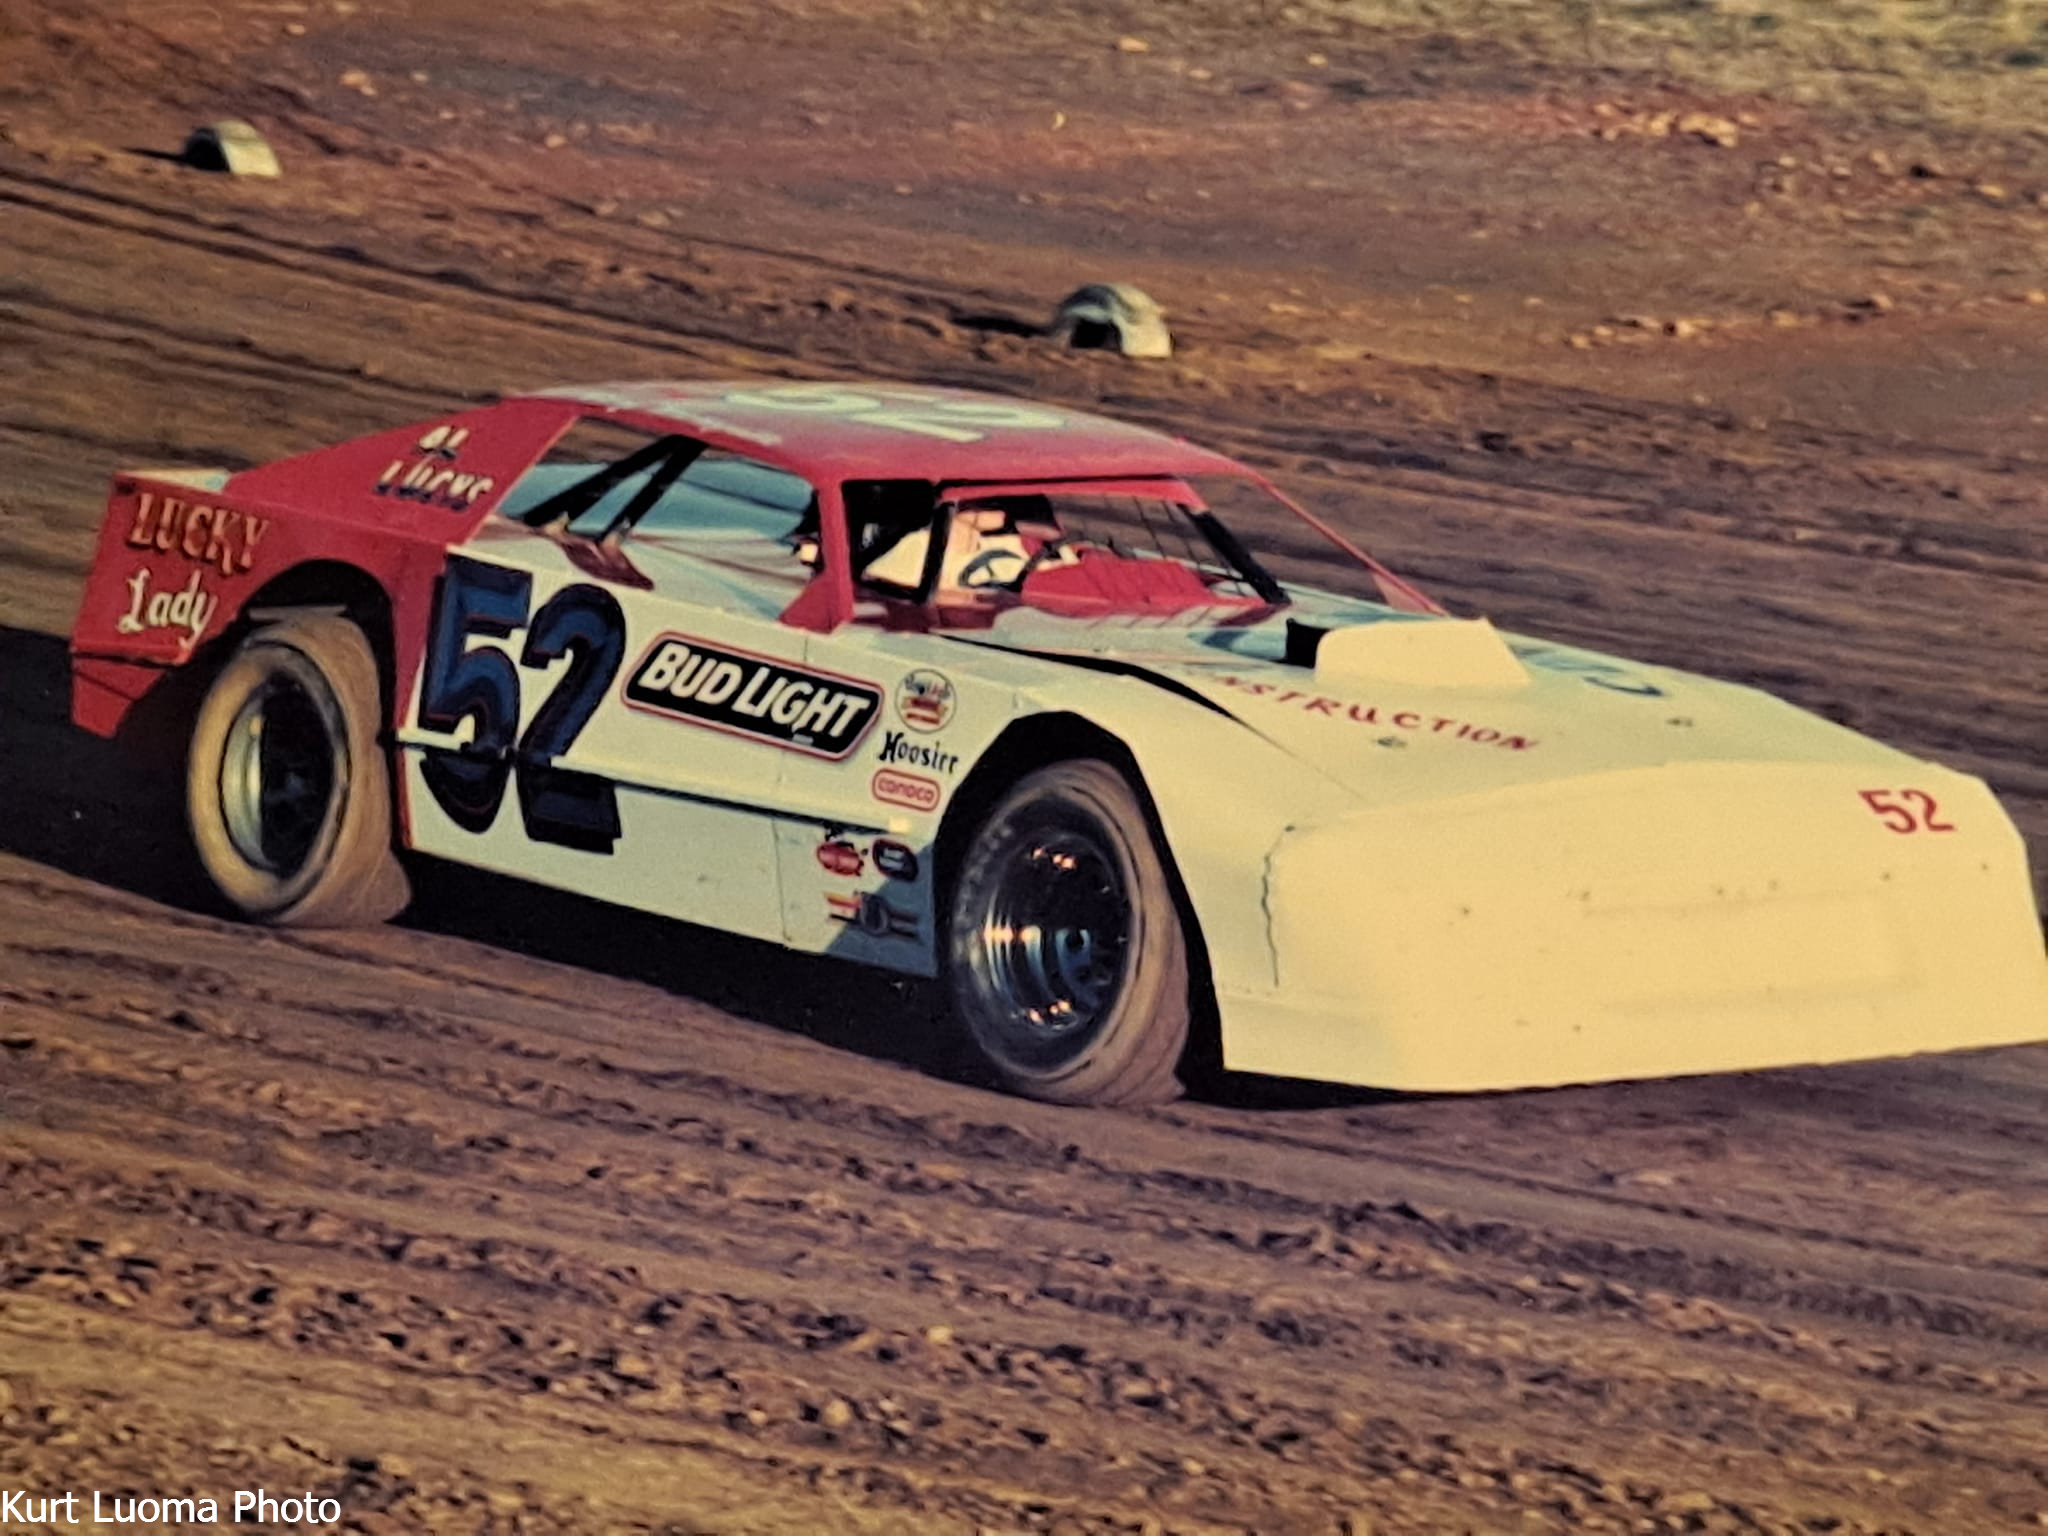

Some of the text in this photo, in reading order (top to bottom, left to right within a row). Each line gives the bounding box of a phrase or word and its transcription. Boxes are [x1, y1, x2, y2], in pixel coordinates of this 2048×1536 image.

[126, 492, 270, 577] LUCKY
[115, 567, 219, 650] Lady
[417, 553, 627, 856] 52
[638, 642, 743, 705] BUD
[731, 666, 871, 738] LIGHT
[1857, 788, 1957, 834] 52
